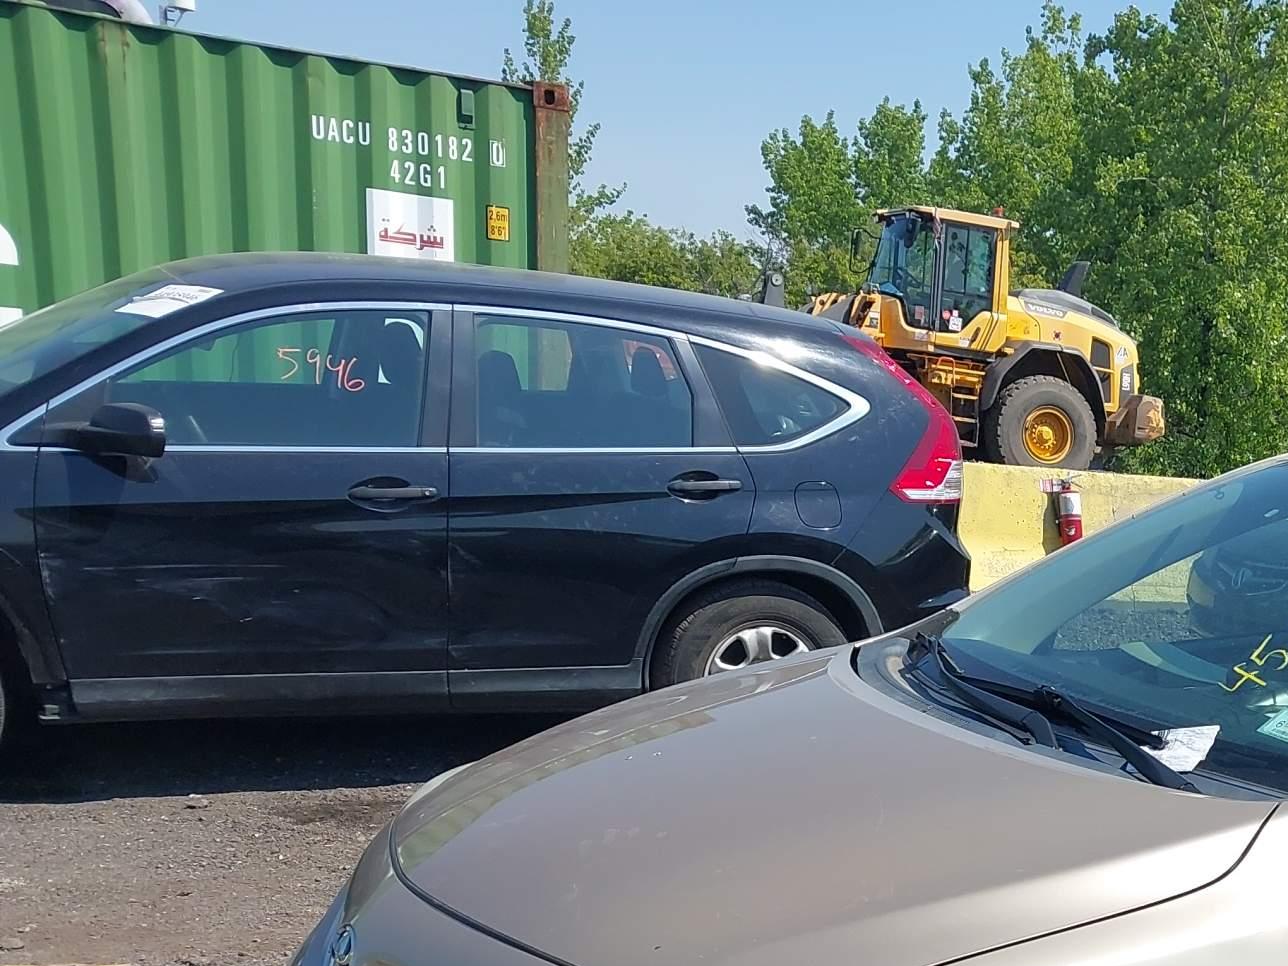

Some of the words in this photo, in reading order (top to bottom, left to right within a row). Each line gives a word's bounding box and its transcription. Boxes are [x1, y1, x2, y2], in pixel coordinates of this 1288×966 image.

[311, 114, 371, 146] UACU
[388, 127, 473, 162] 830182
[390, 159, 446, 189] 42G1
[1027, 303, 1064, 318] VOLVO
[277, 347, 365, 392] 5946
